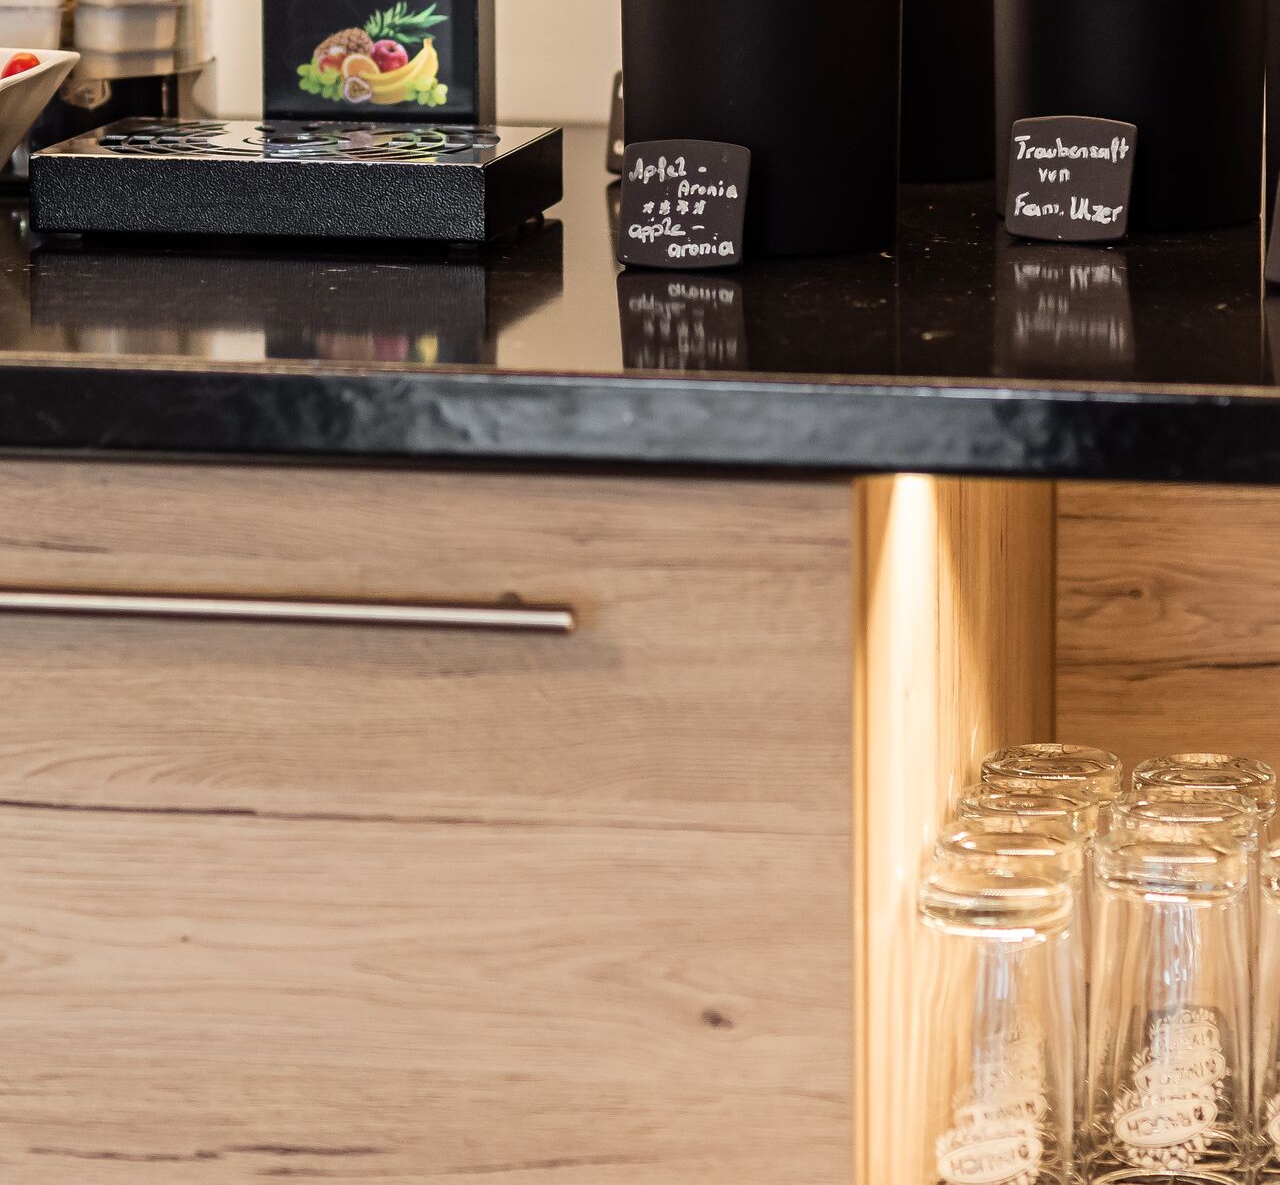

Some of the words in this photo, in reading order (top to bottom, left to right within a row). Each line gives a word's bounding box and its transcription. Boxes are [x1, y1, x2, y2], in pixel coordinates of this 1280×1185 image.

[1014, 134, 1130, 164] Traubensaft
[628, 155, 687, 184] Apfel
[1038, 166, 1071, 183] von
[677, 179, 738, 199] Aronia
[1014, 191, 1065, 216] Fam.
[628, 216, 686, 243] apple
[667, 234, 735, 258] aronia
